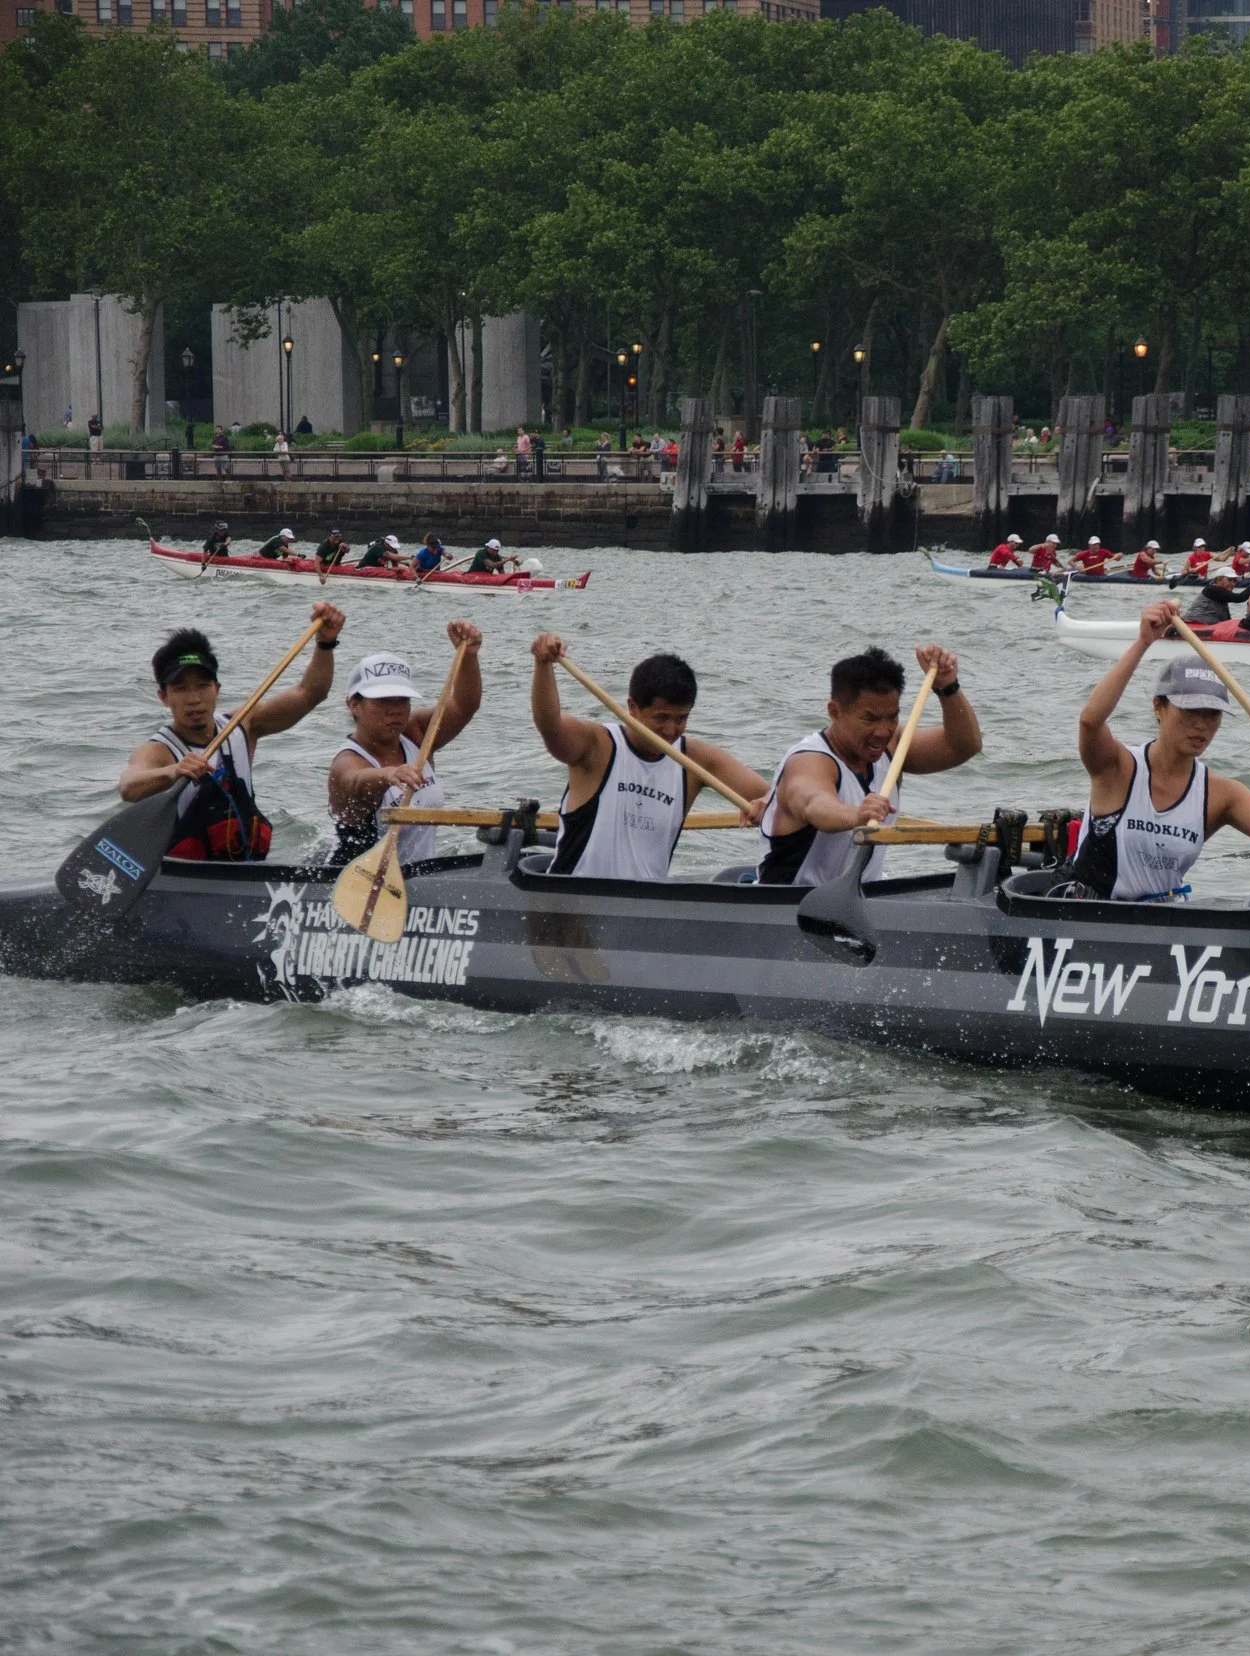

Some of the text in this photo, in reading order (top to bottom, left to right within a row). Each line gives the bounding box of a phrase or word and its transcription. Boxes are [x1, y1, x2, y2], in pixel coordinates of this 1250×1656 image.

[617, 782, 674, 806] BOOKLYN
[1127, 819, 1199, 843] BROOKLYN
[97, 839, 141, 878] KIALOA
[404, 907, 481, 936] IRLINES
[297, 931, 475, 986] LIBERTY CHALLENGE
[1006, 937, 1152, 1028] New
